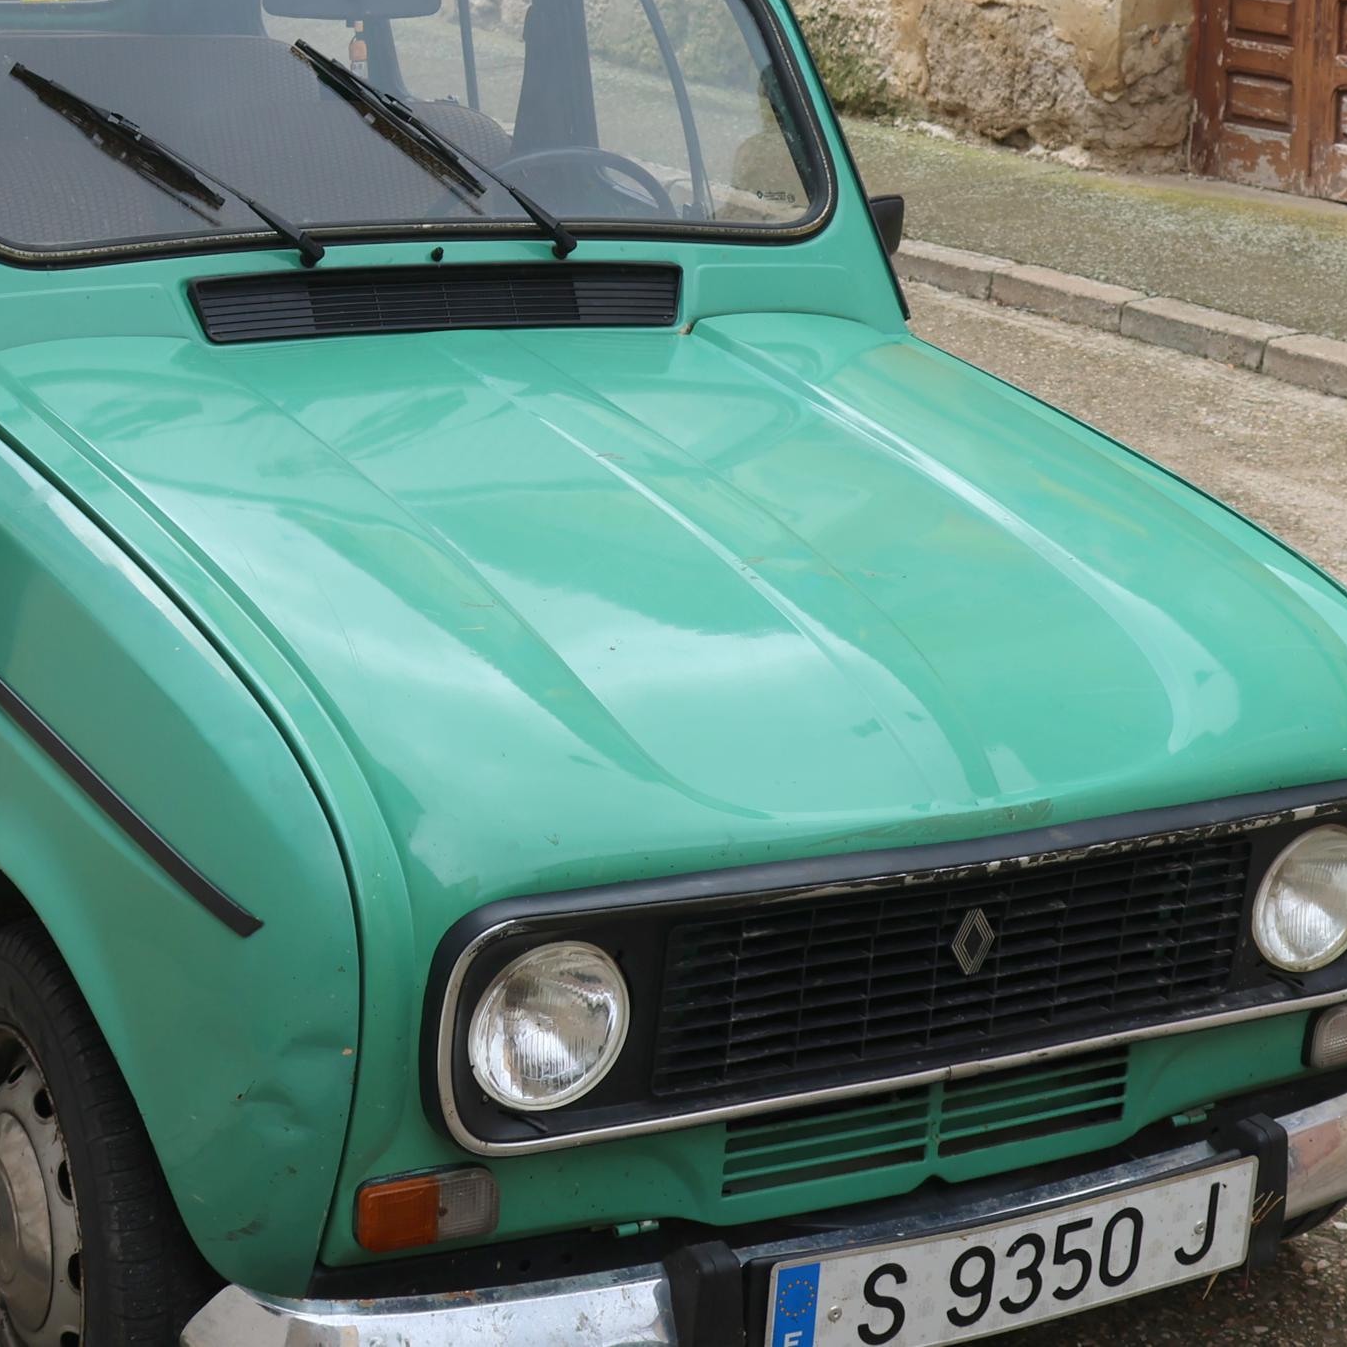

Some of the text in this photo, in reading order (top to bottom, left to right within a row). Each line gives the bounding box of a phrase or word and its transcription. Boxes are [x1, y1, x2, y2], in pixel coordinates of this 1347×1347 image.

[857, 1181, 1222, 1346] S 9350 J
